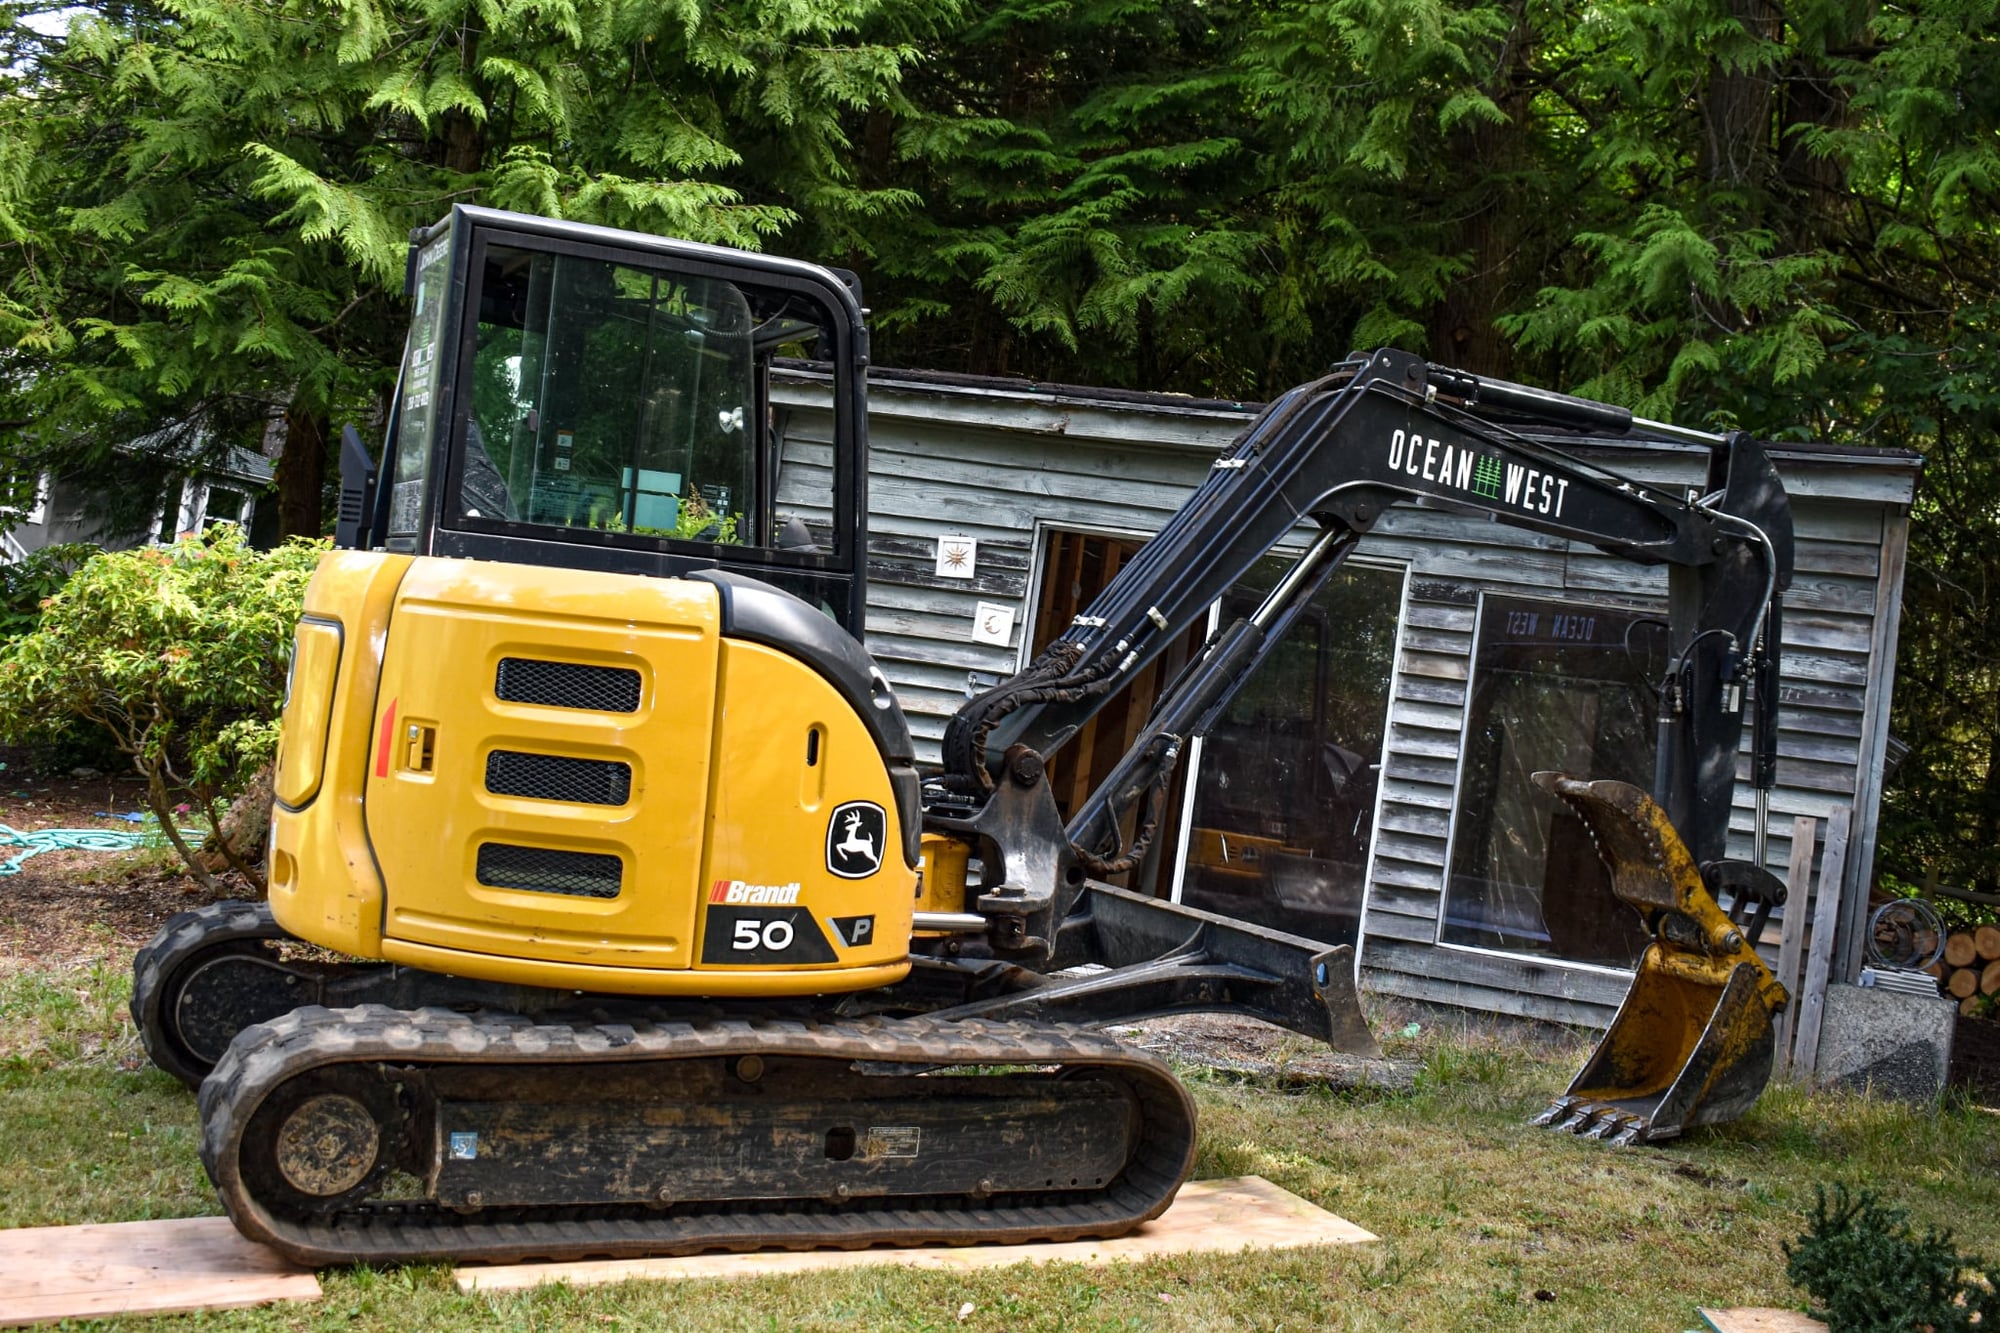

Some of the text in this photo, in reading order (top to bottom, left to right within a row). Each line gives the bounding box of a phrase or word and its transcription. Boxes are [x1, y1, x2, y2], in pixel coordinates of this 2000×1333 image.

[1388, 429, 1569, 518] OCEAN WEST
[725, 881, 800, 904] Brandt
[732, 919, 871, 951] 50 P
